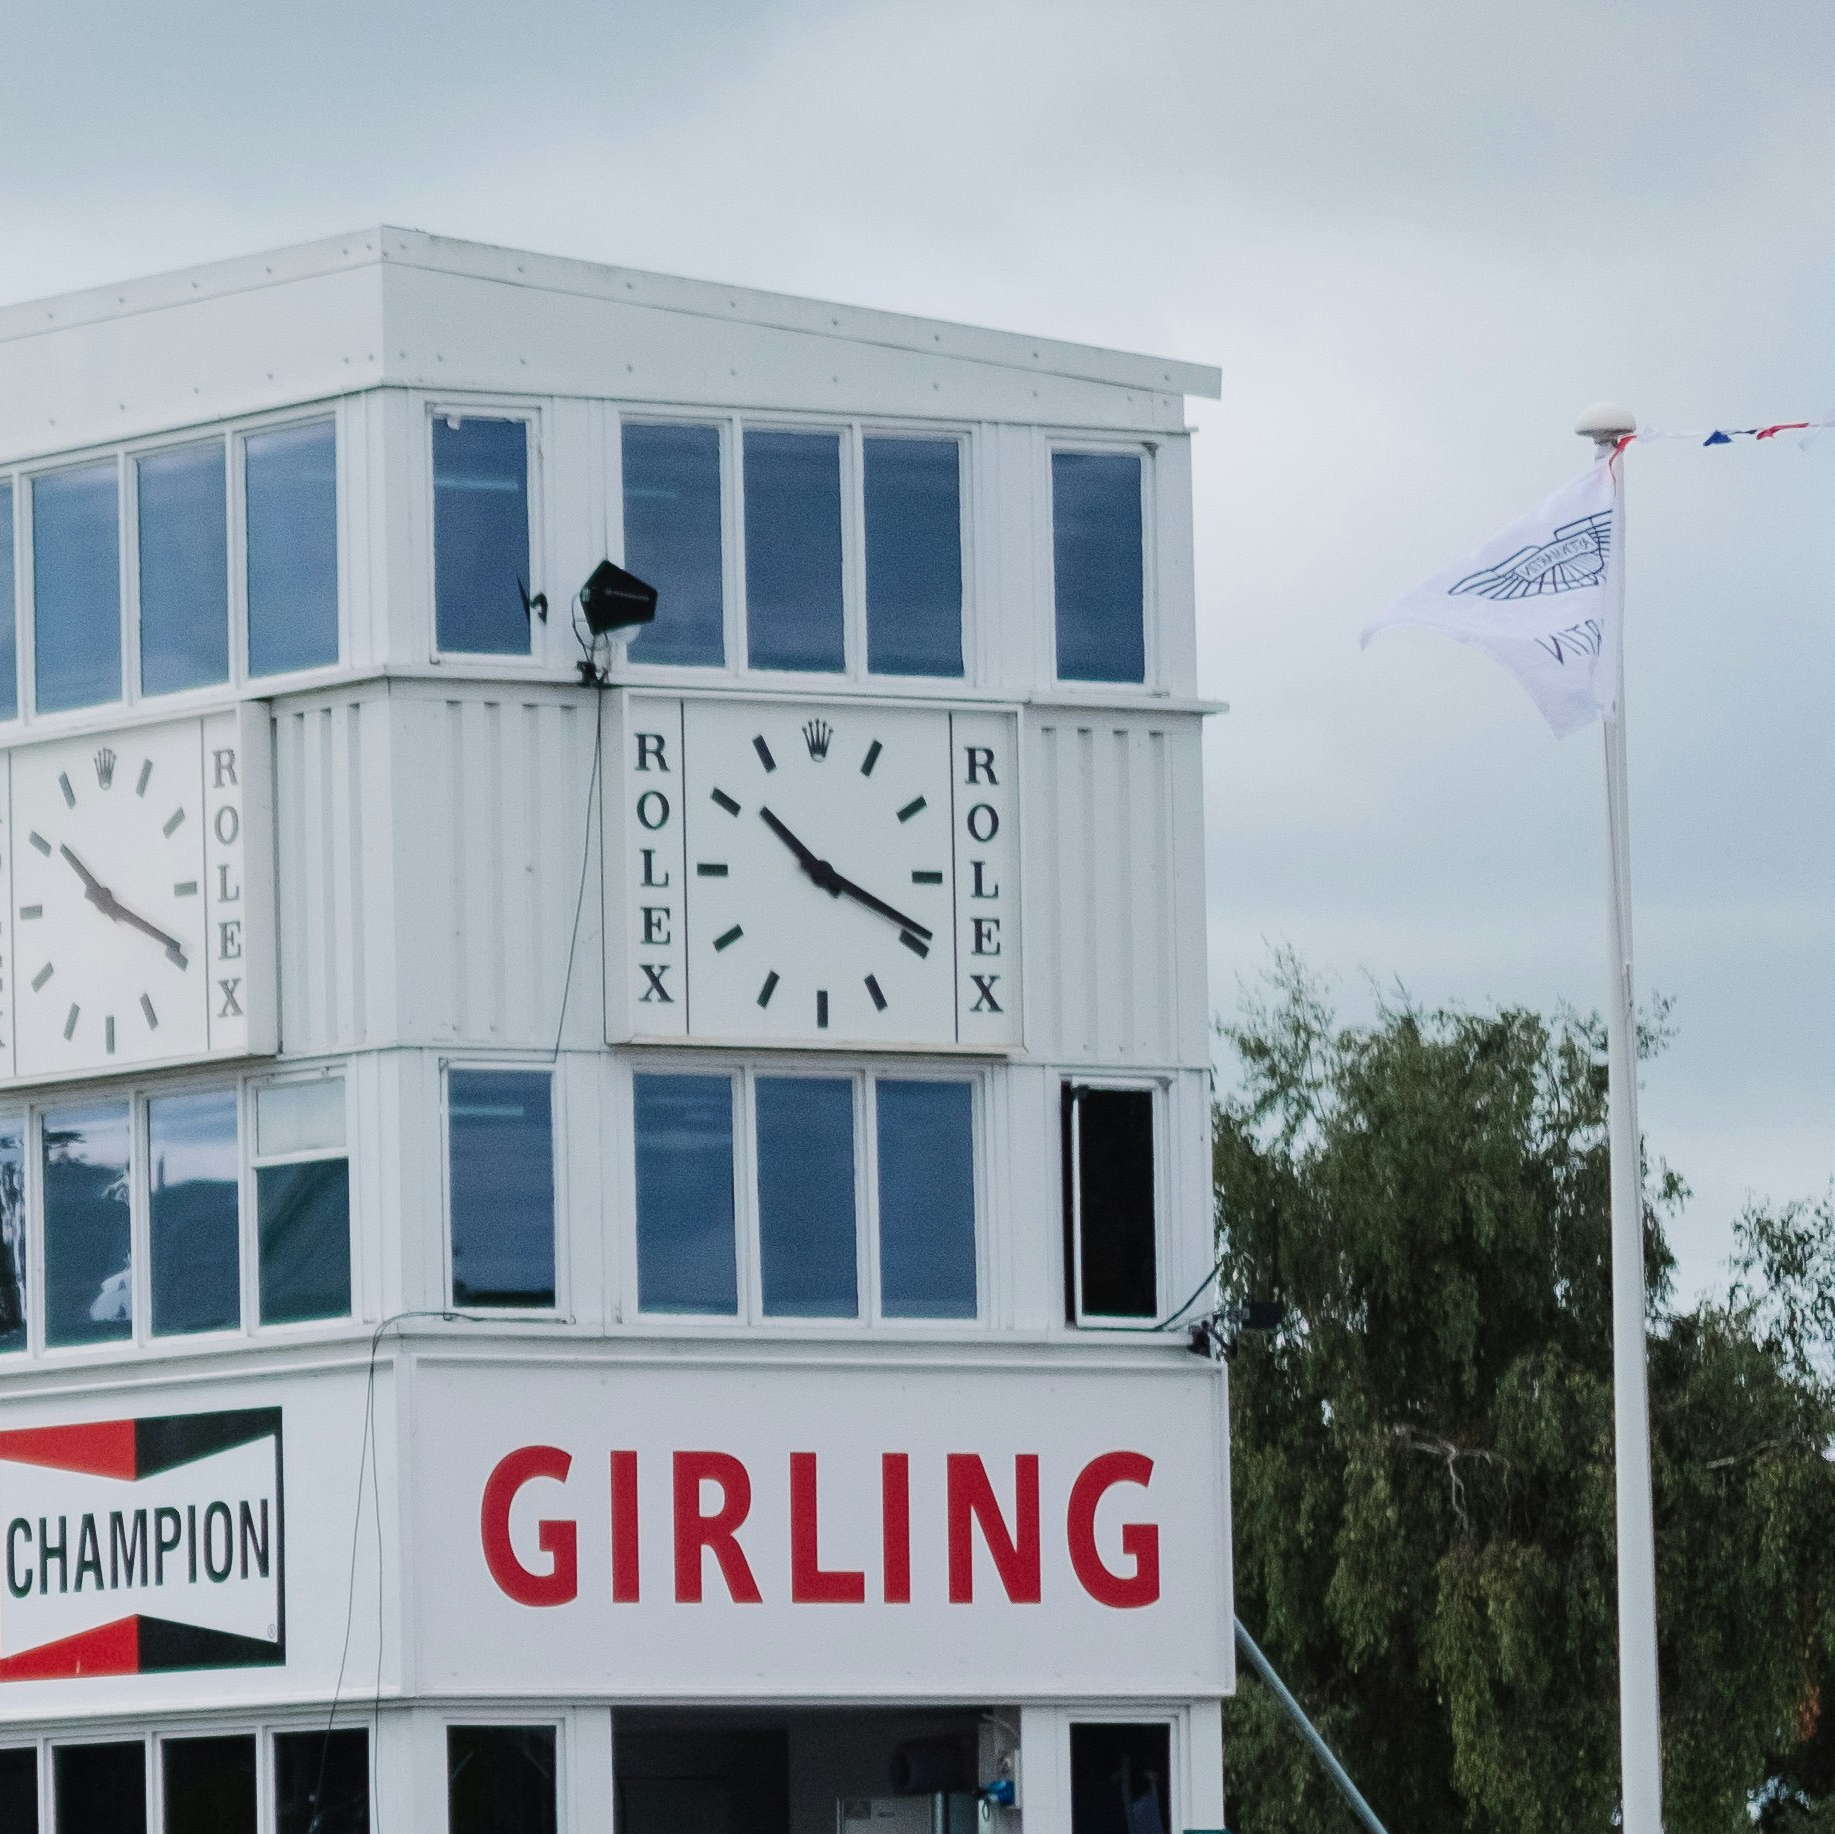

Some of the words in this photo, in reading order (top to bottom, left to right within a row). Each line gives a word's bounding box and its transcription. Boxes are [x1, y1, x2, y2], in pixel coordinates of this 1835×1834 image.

[211, 748, 245, 1019] ROLEX
[634, 732, 674, 1004] ROLEX
[963, 745, 1005, 1016] ROLEX
[6, 1498, 270, 1598] CHAMPION
[481, 1445, 1160, 1608] GIRLING
